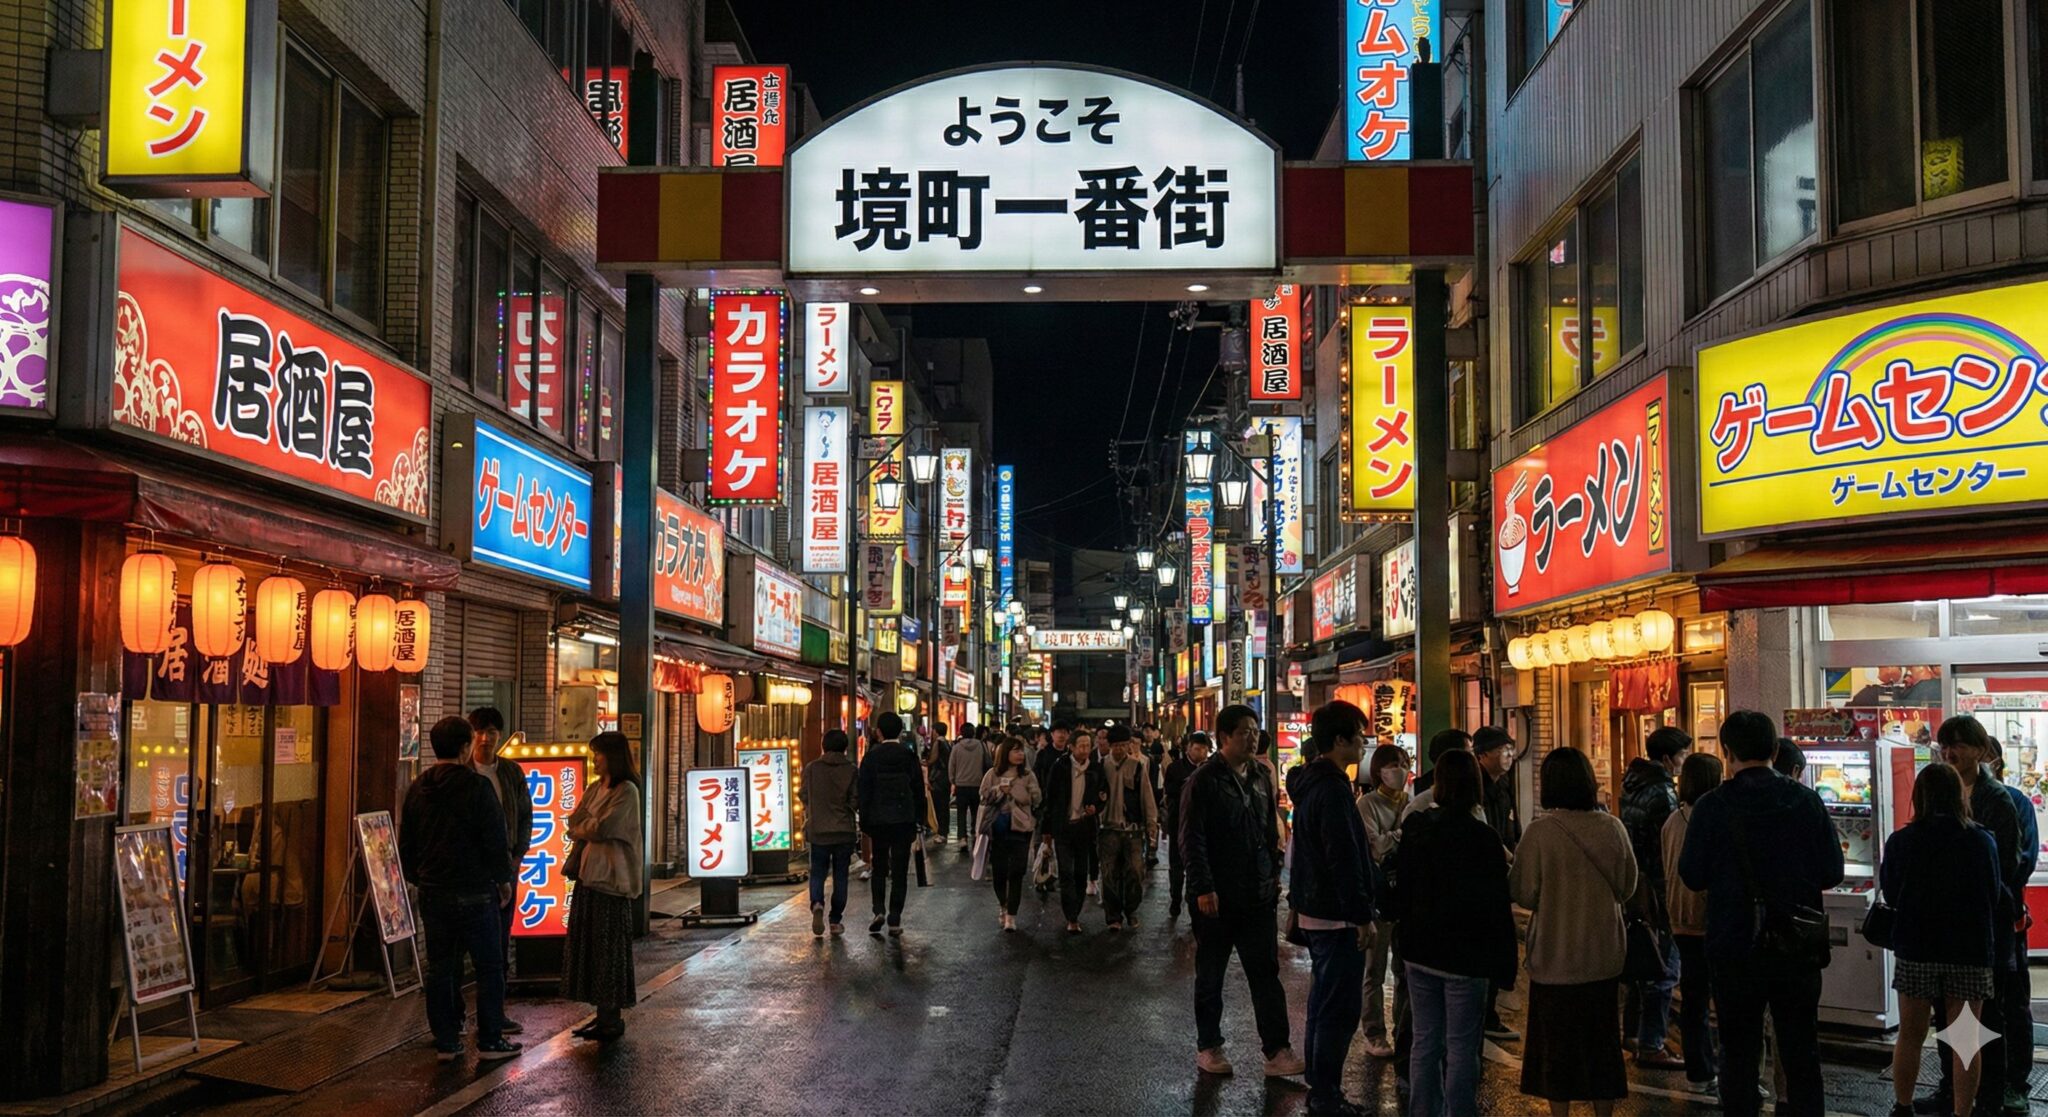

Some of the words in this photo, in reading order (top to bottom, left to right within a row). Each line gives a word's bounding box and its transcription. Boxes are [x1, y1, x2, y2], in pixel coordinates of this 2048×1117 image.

[943, 96, 1121, 146] ようこそ
[1356, 0, 1410, 160] ムオケ
[834, 166, 1229, 251] 境町一番街
[212, 307, 374, 479] 居酒屋
[724, 302, 768, 491] カラオケ
[817, 307, 838, 387] ラーメン
[1261, 316, 1289, 394] 居酒屋
[1368, 317, 1413, 500] ラーメン
[1711, 354, 2048, 472] ゲームセン
[479, 457, 588, 556] ゲームセンター
[811, 462, 839, 540] 居酒屋
[1532, 434, 1642, 574] ラーメン
[1648, 403, 1664, 546] ラーメン
[1831, 461, 2026, 505] ゲームセンター
[397, 610, 416, 661] 居酒屋
[519, 770, 556, 928] カラオケ
[699, 777, 723, 870] ラーメン
